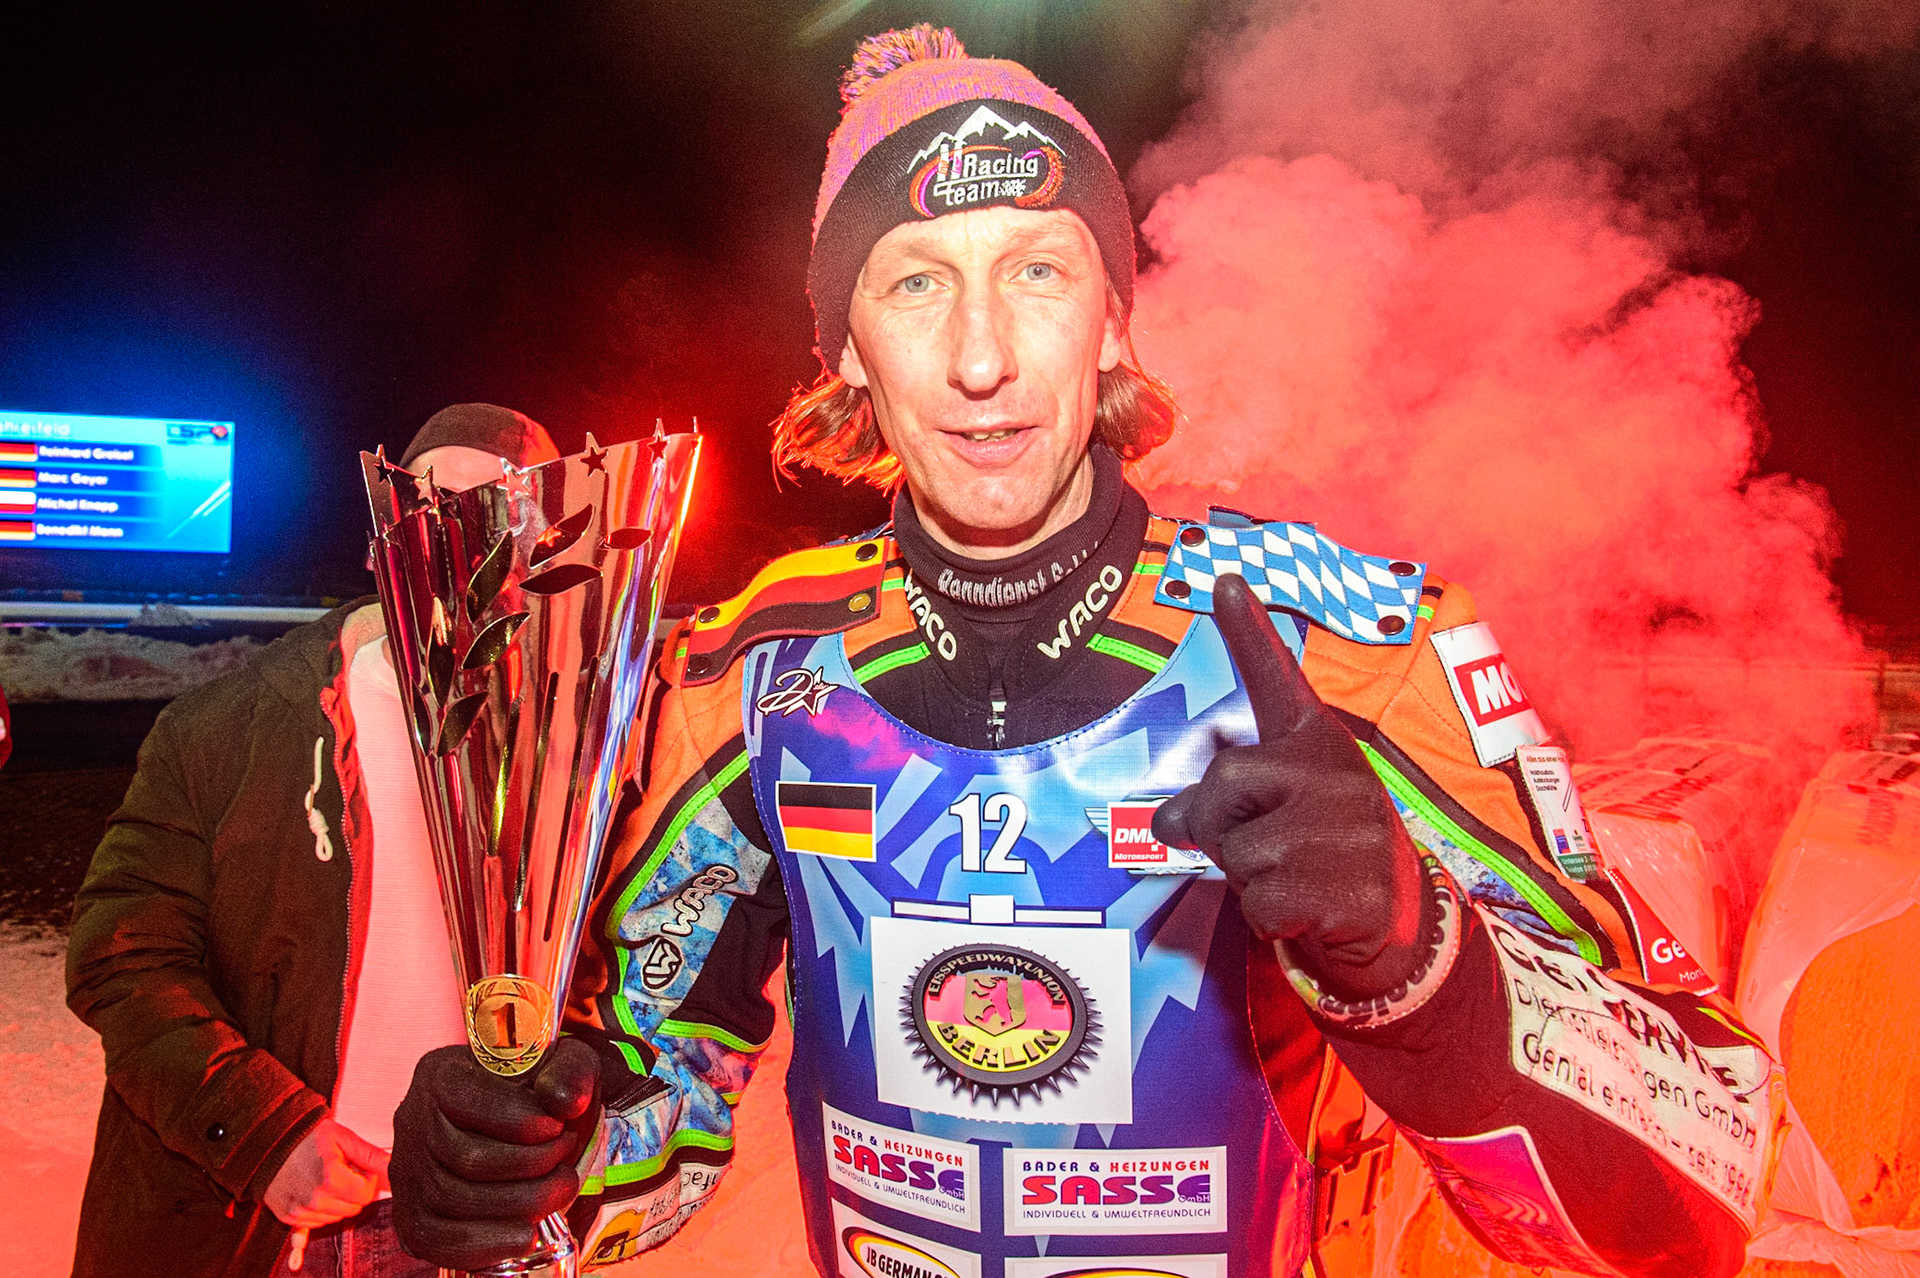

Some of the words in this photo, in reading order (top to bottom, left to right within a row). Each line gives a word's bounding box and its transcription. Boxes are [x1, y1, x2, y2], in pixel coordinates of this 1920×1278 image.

[963, 153, 1038, 178] Racing
[904, 573, 957, 661] WACO
[1037, 564, 1123, 659] WACO
[1470, 661, 1528, 716] MO
[949, 793, 1028, 874] 12
[661, 864, 739, 937] WACO
[928, 953, 1067, 1005] EISSPEEDWAYUNION
[491, 1002, 523, 1049] 1
[937, 1022, 1061, 1068] BERLIN
[833, 1134, 965, 1200] SASSE
[869, 1135, 878, 1146] &
[884, 1139, 963, 1167] HEIZUNGEN
[1089, 1161, 1100, 1172] &
[1110, 1159, 1210, 1173] HEIZUNGEN
[836, 1163, 871, 1187] INDIVIDUELL
[883, 1185, 966, 1214] UMWELTFREUNDLICH
[1022, 1173, 1211, 1206] SASSE
[1178, 1194, 1211, 1204] GmbH
[1023, 1209, 1087, 1219] INDIVIDUELL
[1092, 1209, 1099, 1219] &
[1104, 1208, 1211, 1220] UMWELTFREUNDLICH
[866, 1246, 877, 1267] JB
